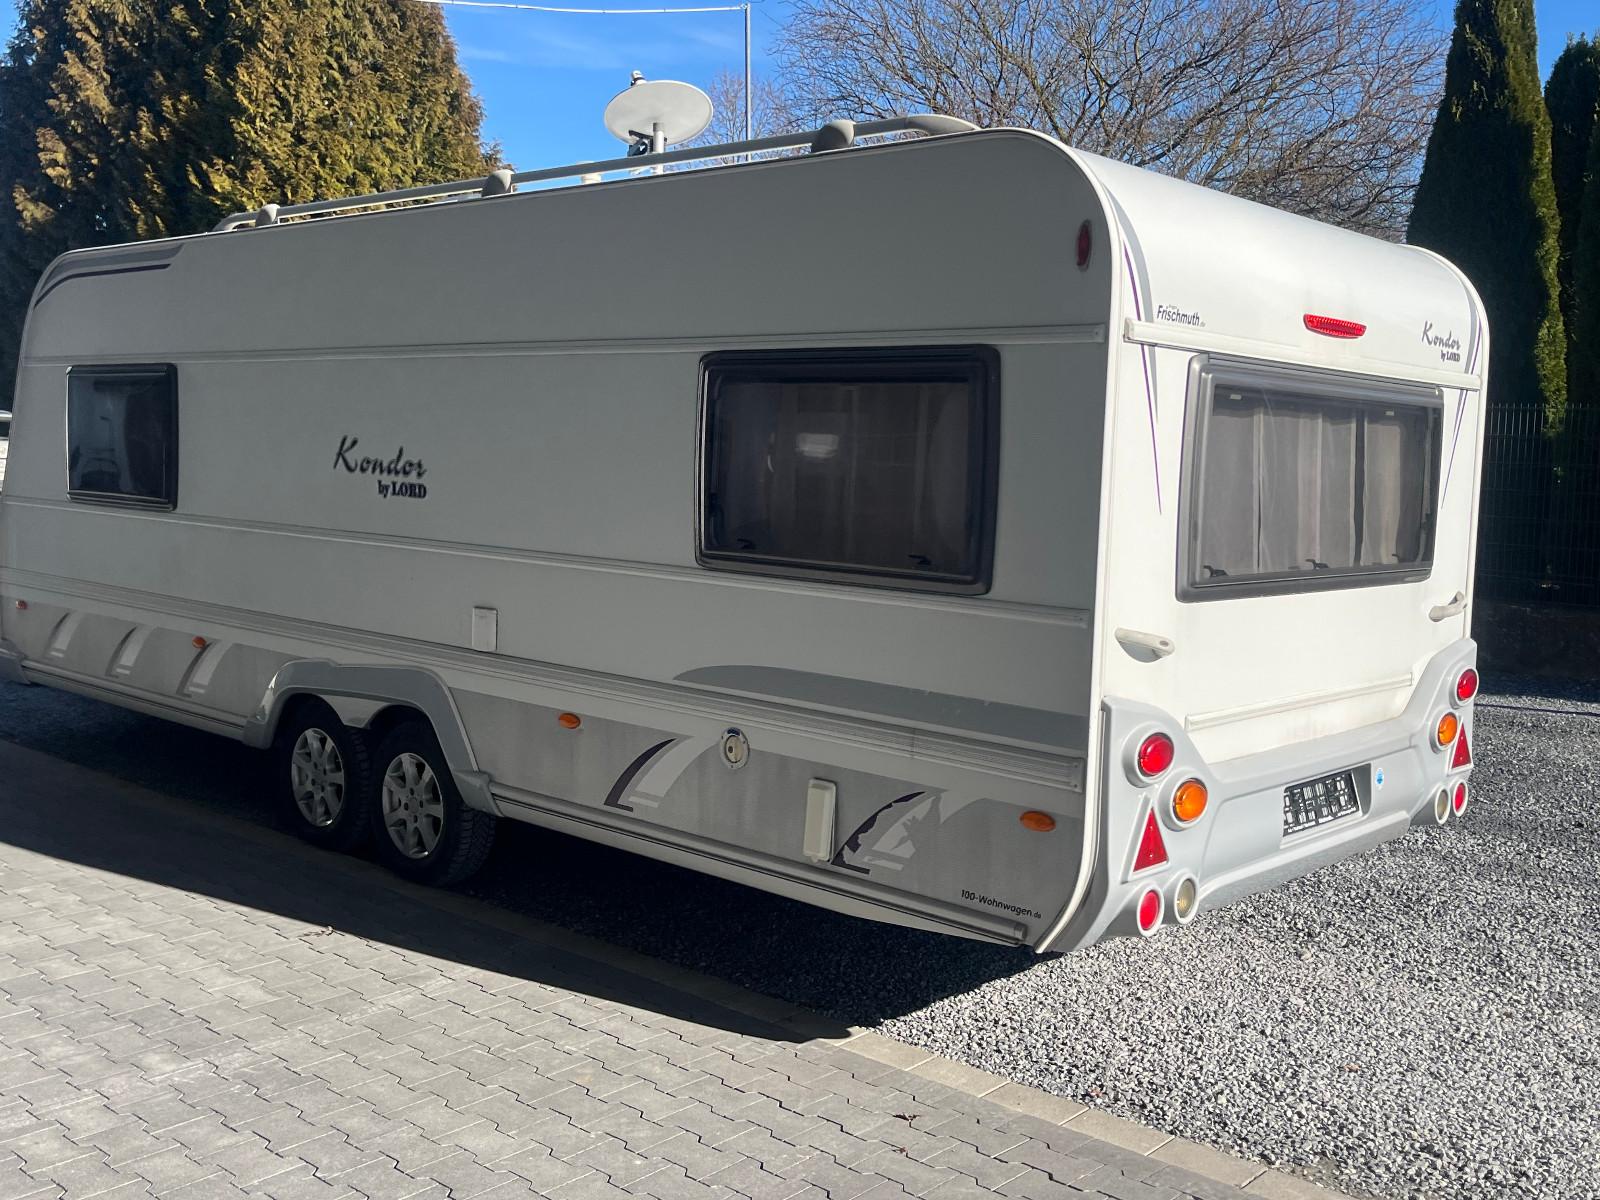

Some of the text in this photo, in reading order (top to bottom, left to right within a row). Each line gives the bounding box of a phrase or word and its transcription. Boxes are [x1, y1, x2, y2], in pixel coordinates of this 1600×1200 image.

[1421, 319, 1461, 351] Kondor
[1446, 351, 1461, 362] LORD
[333, 435, 427, 479] Kondor
[377, 479, 427, 499] by LORD
